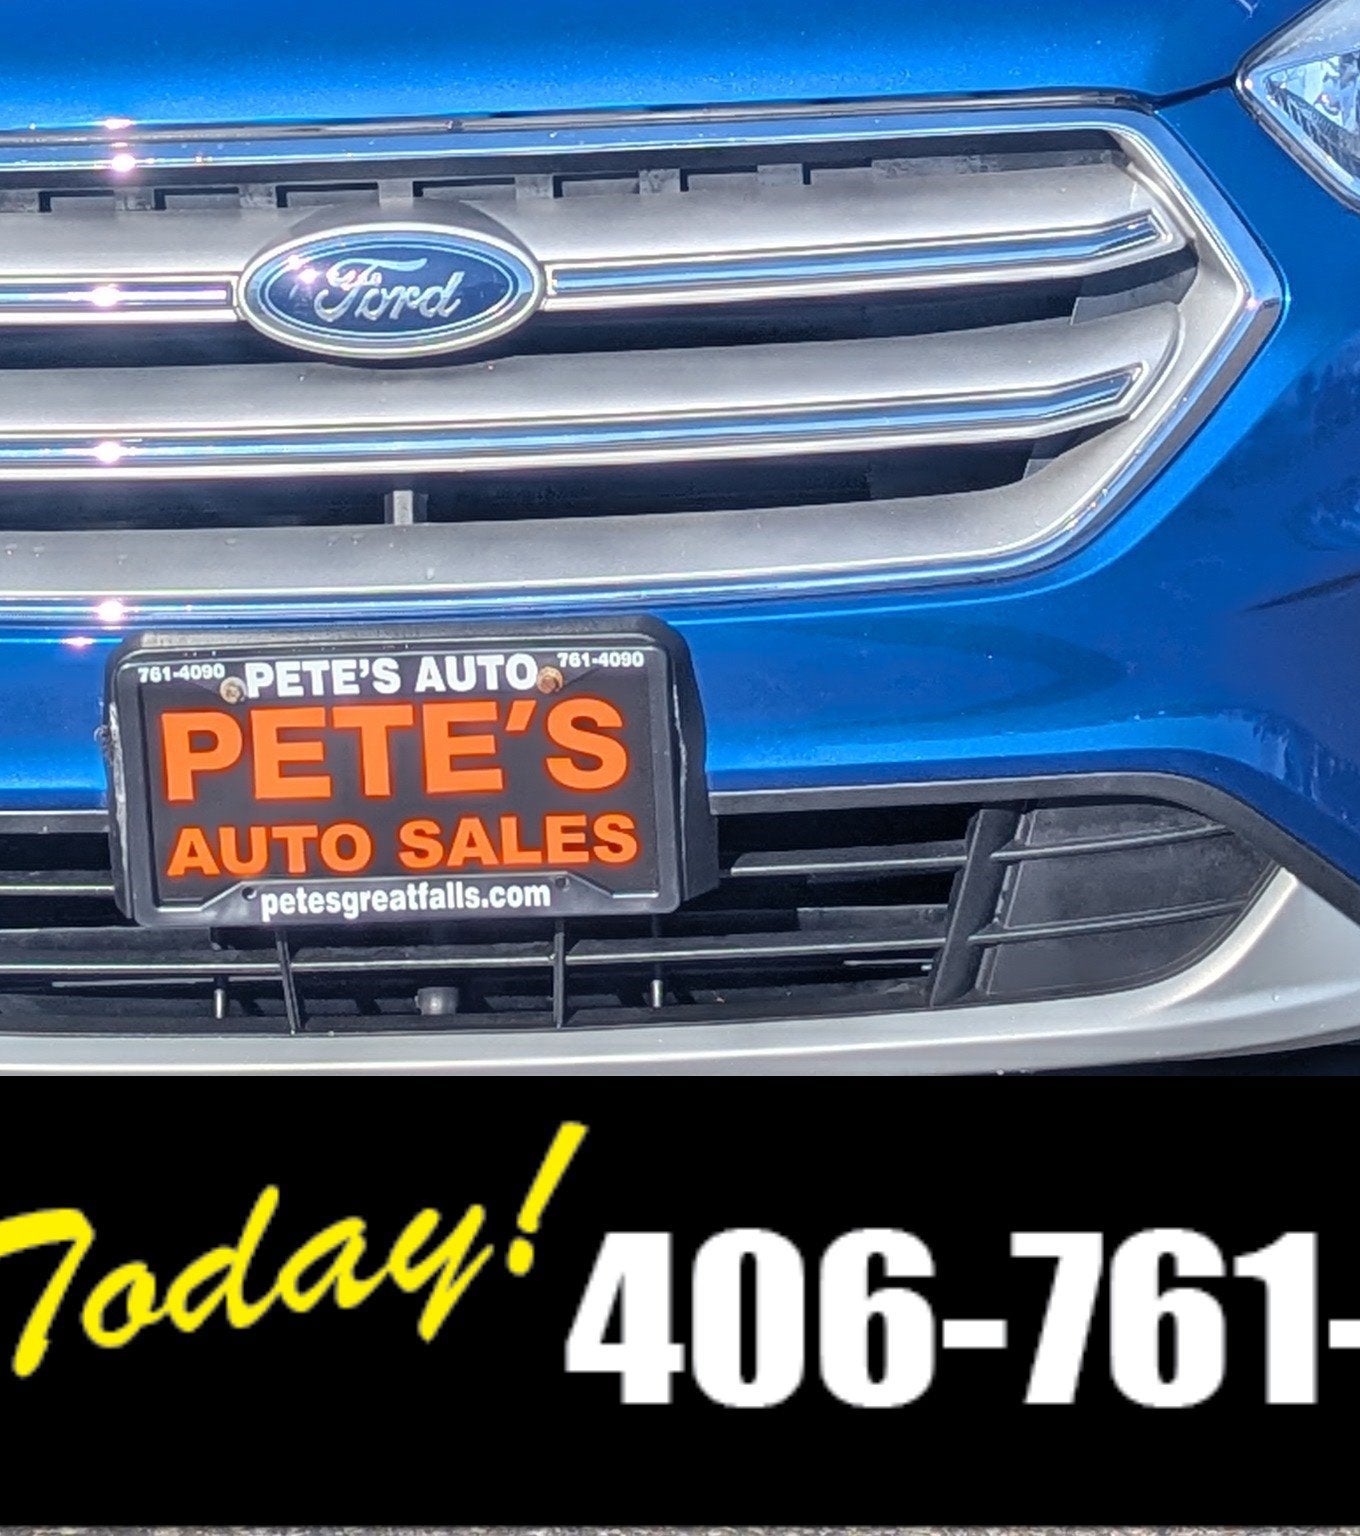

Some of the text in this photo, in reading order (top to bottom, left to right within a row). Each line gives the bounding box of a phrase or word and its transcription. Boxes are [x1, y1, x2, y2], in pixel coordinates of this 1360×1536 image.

[313, 258, 465, 322] Ford
[138, 663, 226, 683] 761-4090
[244, 652, 540, 698] PETE'S AUTO
[557, 651, 645, 669] 761-4090
[161, 697, 630, 802] PETE'S
[167, 813, 638, 877] AUTO SALES
[260, 880, 552, 922] petesgreatfalls.com
